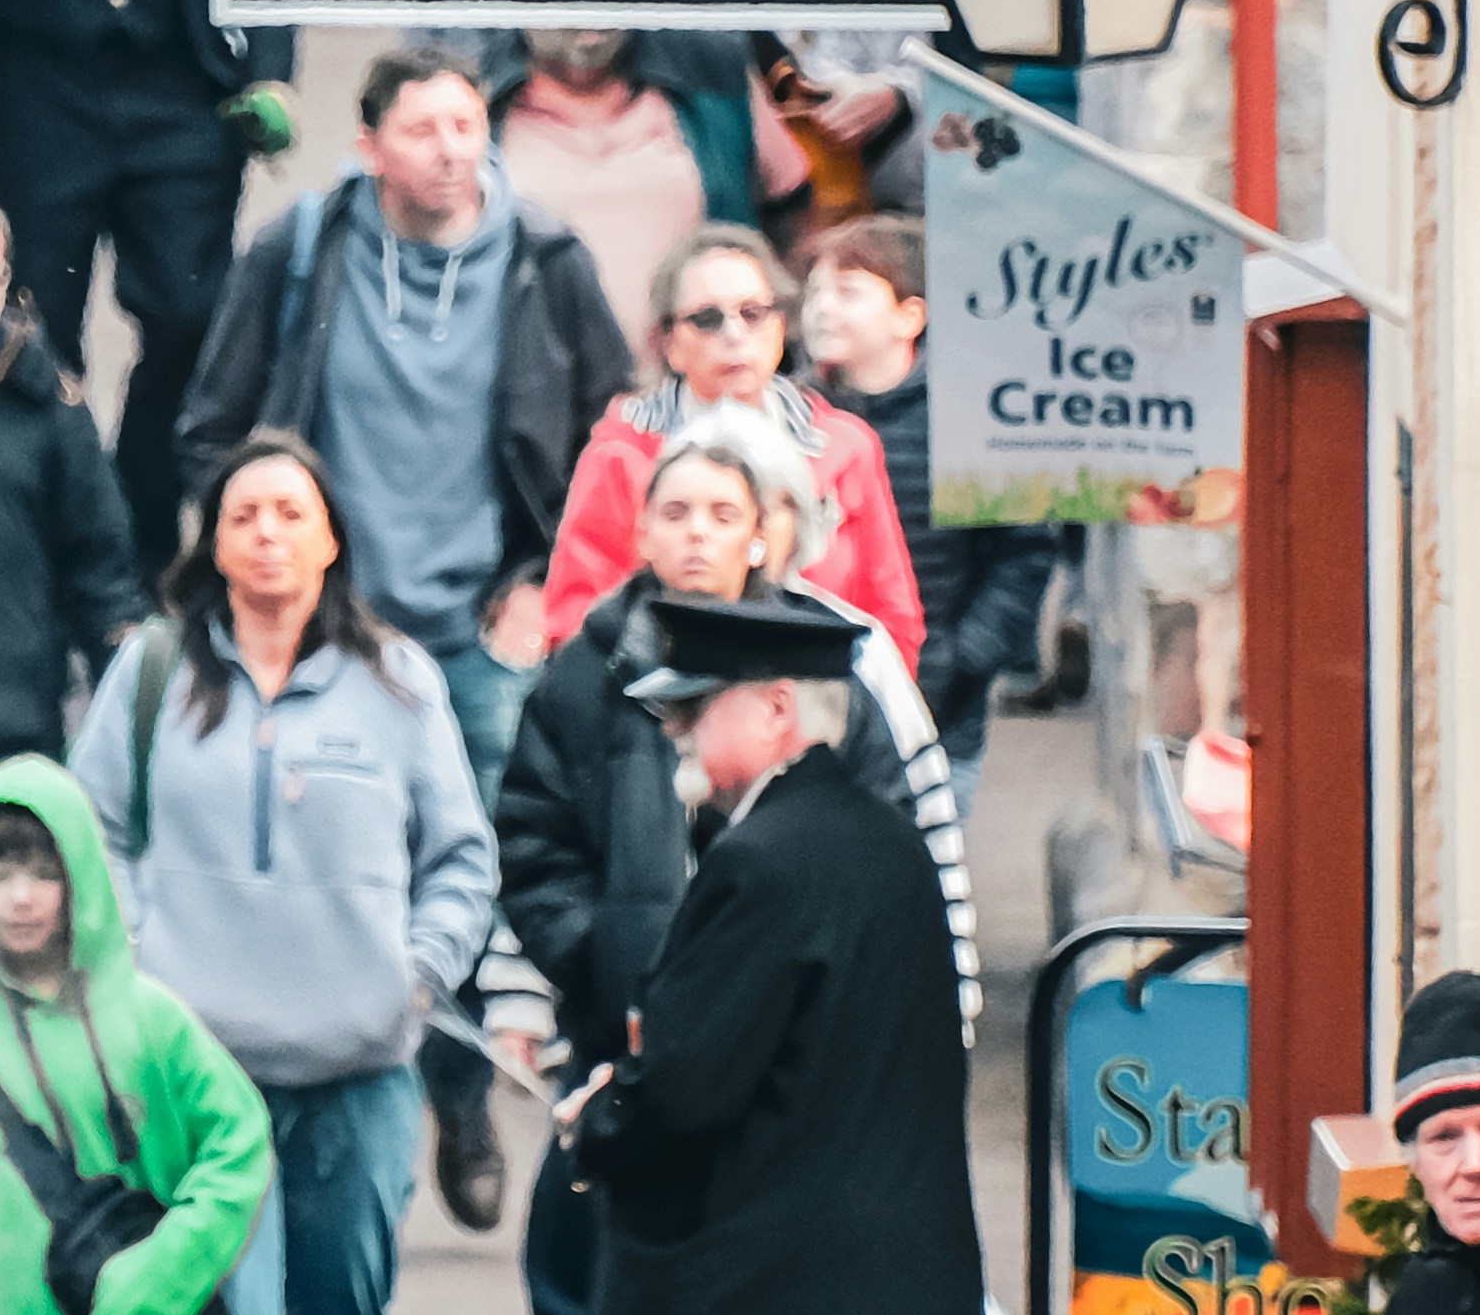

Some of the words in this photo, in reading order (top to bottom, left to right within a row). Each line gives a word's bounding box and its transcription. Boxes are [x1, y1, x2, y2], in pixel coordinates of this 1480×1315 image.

[965, 213, 1199, 332] Styles
[1049, 337, 1135, 382] Ice
[987, 381, 1195, 434] Cream
